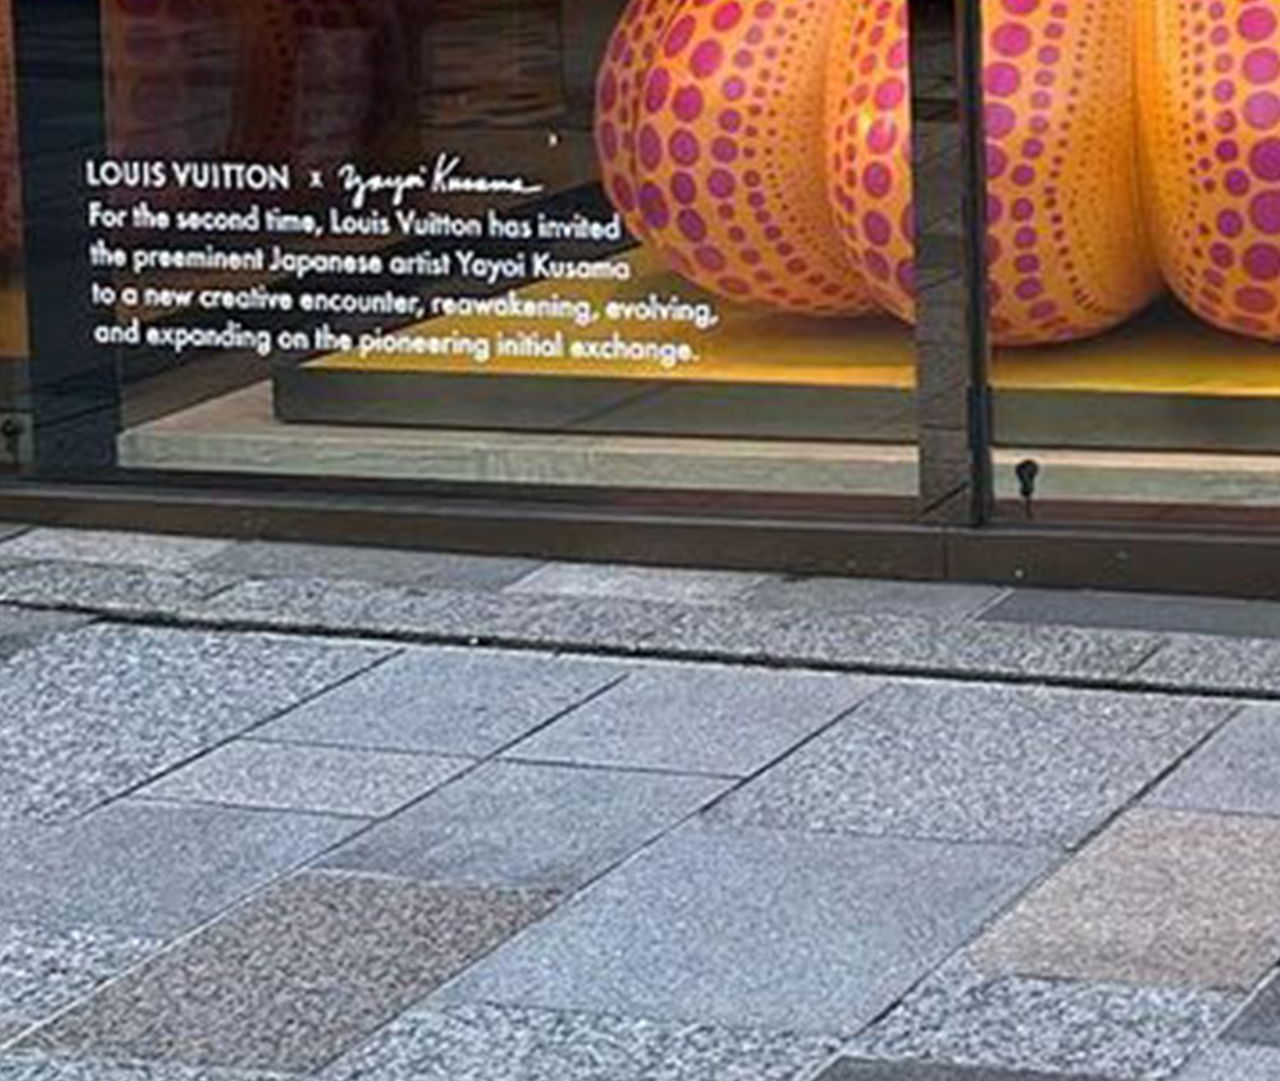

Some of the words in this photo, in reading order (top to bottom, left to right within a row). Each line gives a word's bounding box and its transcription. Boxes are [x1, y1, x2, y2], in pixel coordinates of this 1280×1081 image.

[86, 160, 167, 188] LOUIS
[171, 161, 290, 191] VUITTON
[338, 163, 427, 209] Yayoi
[88, 201, 127, 228] For
[132, 201, 170, 229] the
[176, 204, 260, 232] second
[264, 207, 323, 237] time,
[329, 207, 391, 236] Louis
[394, 208, 482, 237] Vuitton
[487, 209, 532, 238] has
[537, 212, 621, 240] invited
[89, 240, 127, 268] the
[132, 245, 264, 274] preeminent
[269, 246, 383, 279] Japanese
[388, 251, 449, 276] artist
[455, 250, 526, 284] Yayoi
[532, 252, 631, 280] Kusama
[91, 283, 116, 305] to
[121, 286, 138, 306] a
[144, 288, 195, 308] new
[199, 285, 294, 311] creative
[299, 291, 425, 318] encounter,
[430, 290, 600, 325] reawakening,
[605, 293, 719, 329] evolving,
[93, 317, 140, 345] and
[146, 321, 272, 356] expanding
[276, 330, 310, 350] on
[314, 323, 353, 351] the
[358, 328, 490, 362] pioneering
[496, 330, 564, 358] initial
[569, 330, 700, 368] exchange.
